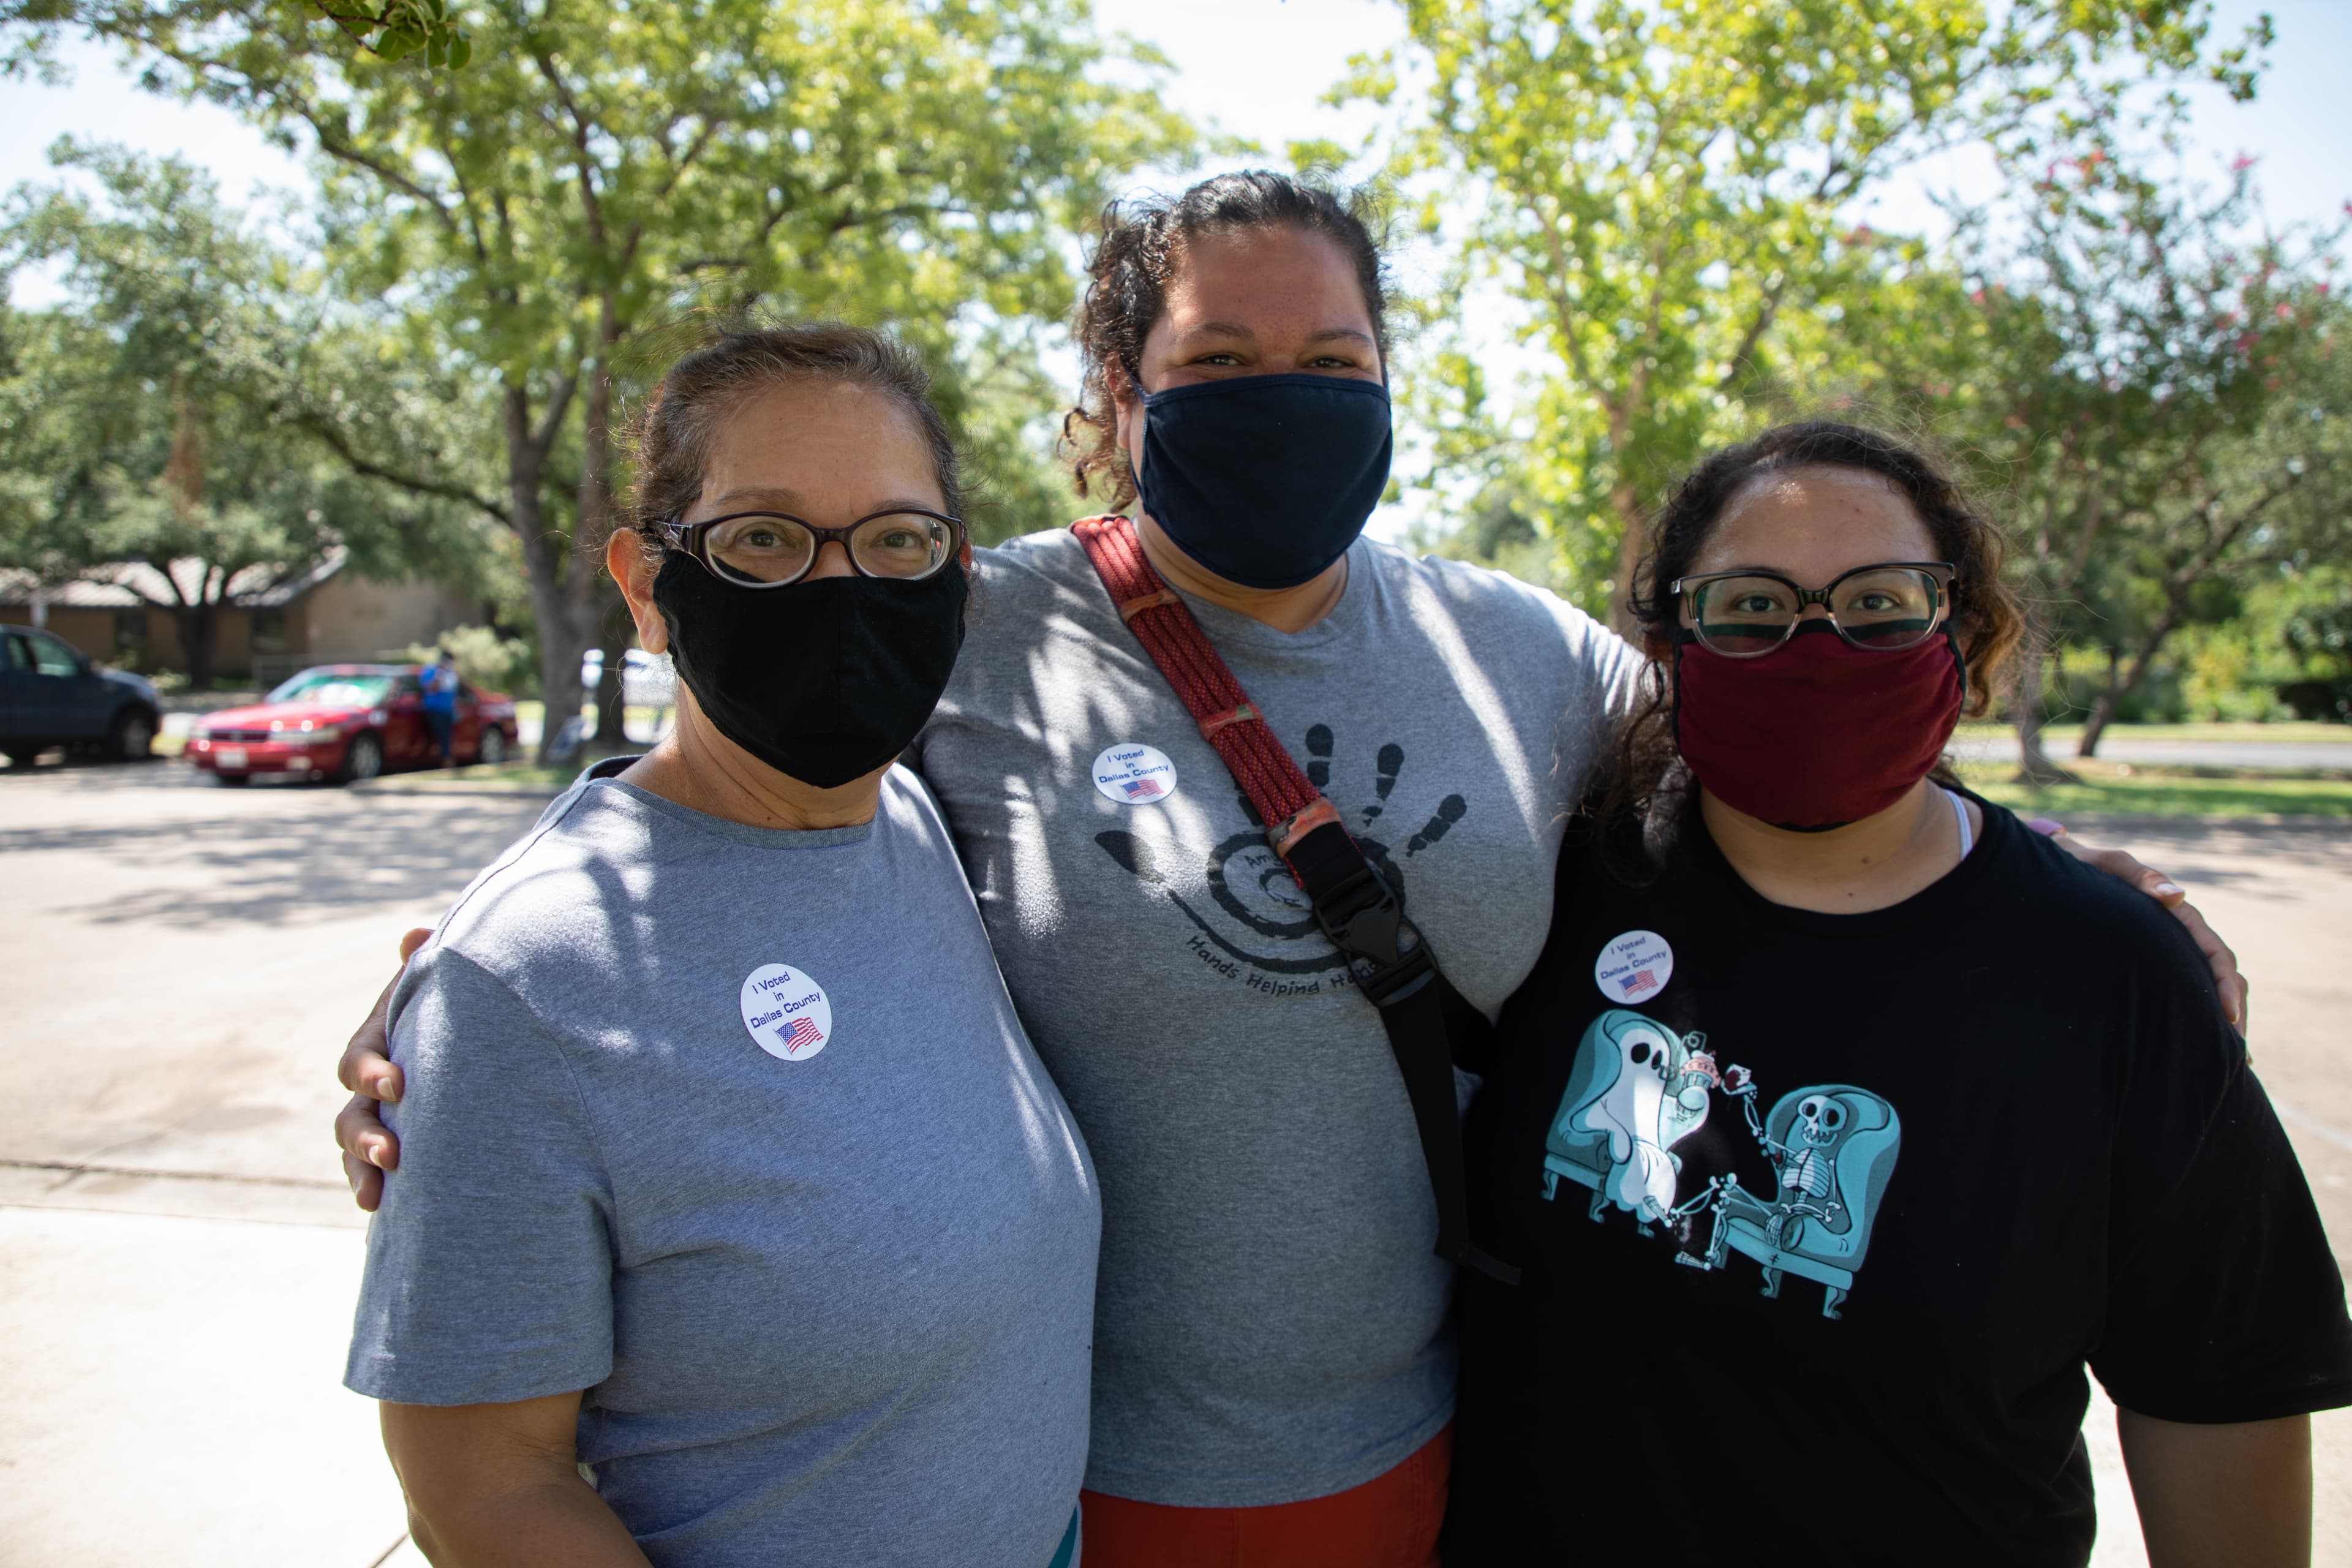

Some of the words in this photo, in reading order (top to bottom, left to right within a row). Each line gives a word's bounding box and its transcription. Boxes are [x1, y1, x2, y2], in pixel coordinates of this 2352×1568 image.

[1113, 749, 1145, 761] Voted
[1098, 773, 1130, 783] Dallas
[1133, 764, 1169, 777] County
[1616, 936, 1646, 952] Voted
[1185, 935, 1240, 979] Hands
[1246, 973, 1320, 998] Helping
[1600, 964, 1630, 979] Dallas
[1632, 950, 1667, 968] County
[752, 984, 759, 995] I
[758, 971, 791, 990] Voted
[773, 992, 785, 1002] in
[750, 1009, 783, 1029] Dallas
[783, 992, 821, 1014] County
